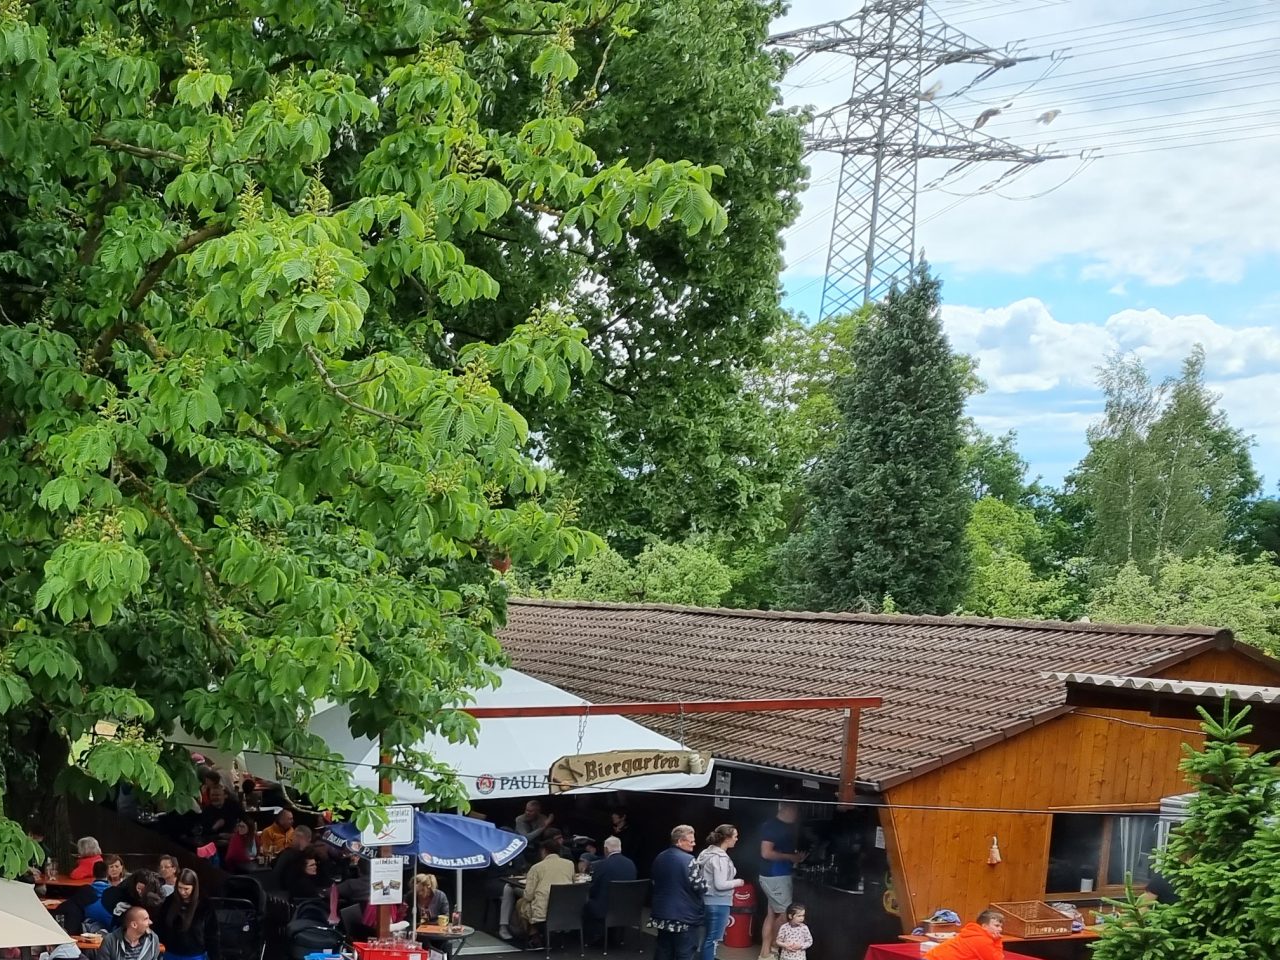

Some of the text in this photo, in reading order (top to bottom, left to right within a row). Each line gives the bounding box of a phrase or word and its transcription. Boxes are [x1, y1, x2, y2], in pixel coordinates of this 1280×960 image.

[584, 752, 681, 783] Biergarten
[500, 774, 550, 790] PAULA
[432, 854, 487, 867] PAULANER
